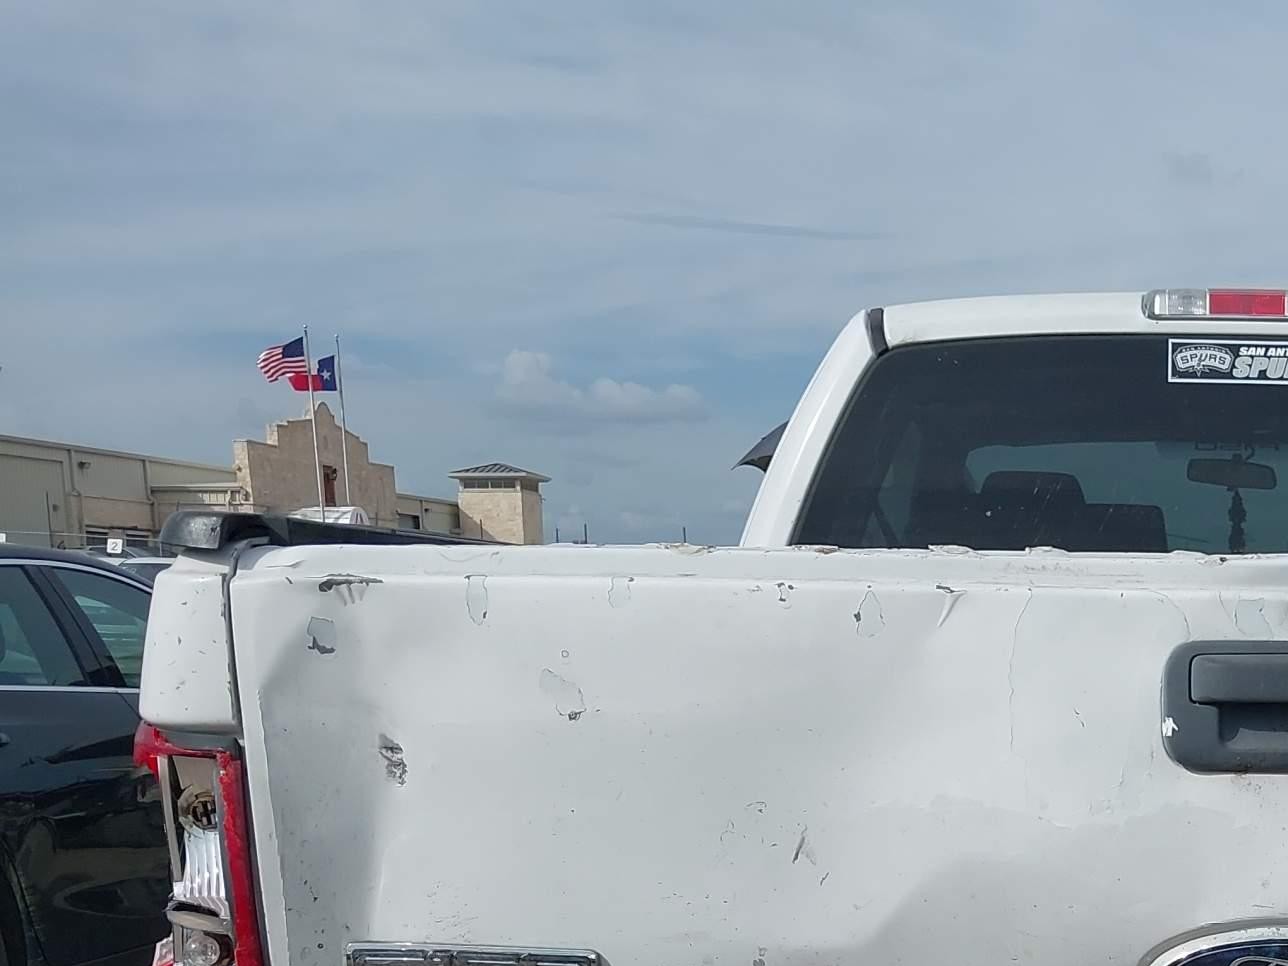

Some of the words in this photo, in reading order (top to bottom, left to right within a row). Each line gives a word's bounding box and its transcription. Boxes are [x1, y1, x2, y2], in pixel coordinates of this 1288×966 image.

[1239, 346, 1265, 356] SAN
[1180, 353, 1227, 366] SPURS
[111, 542, 118, 551] 2
